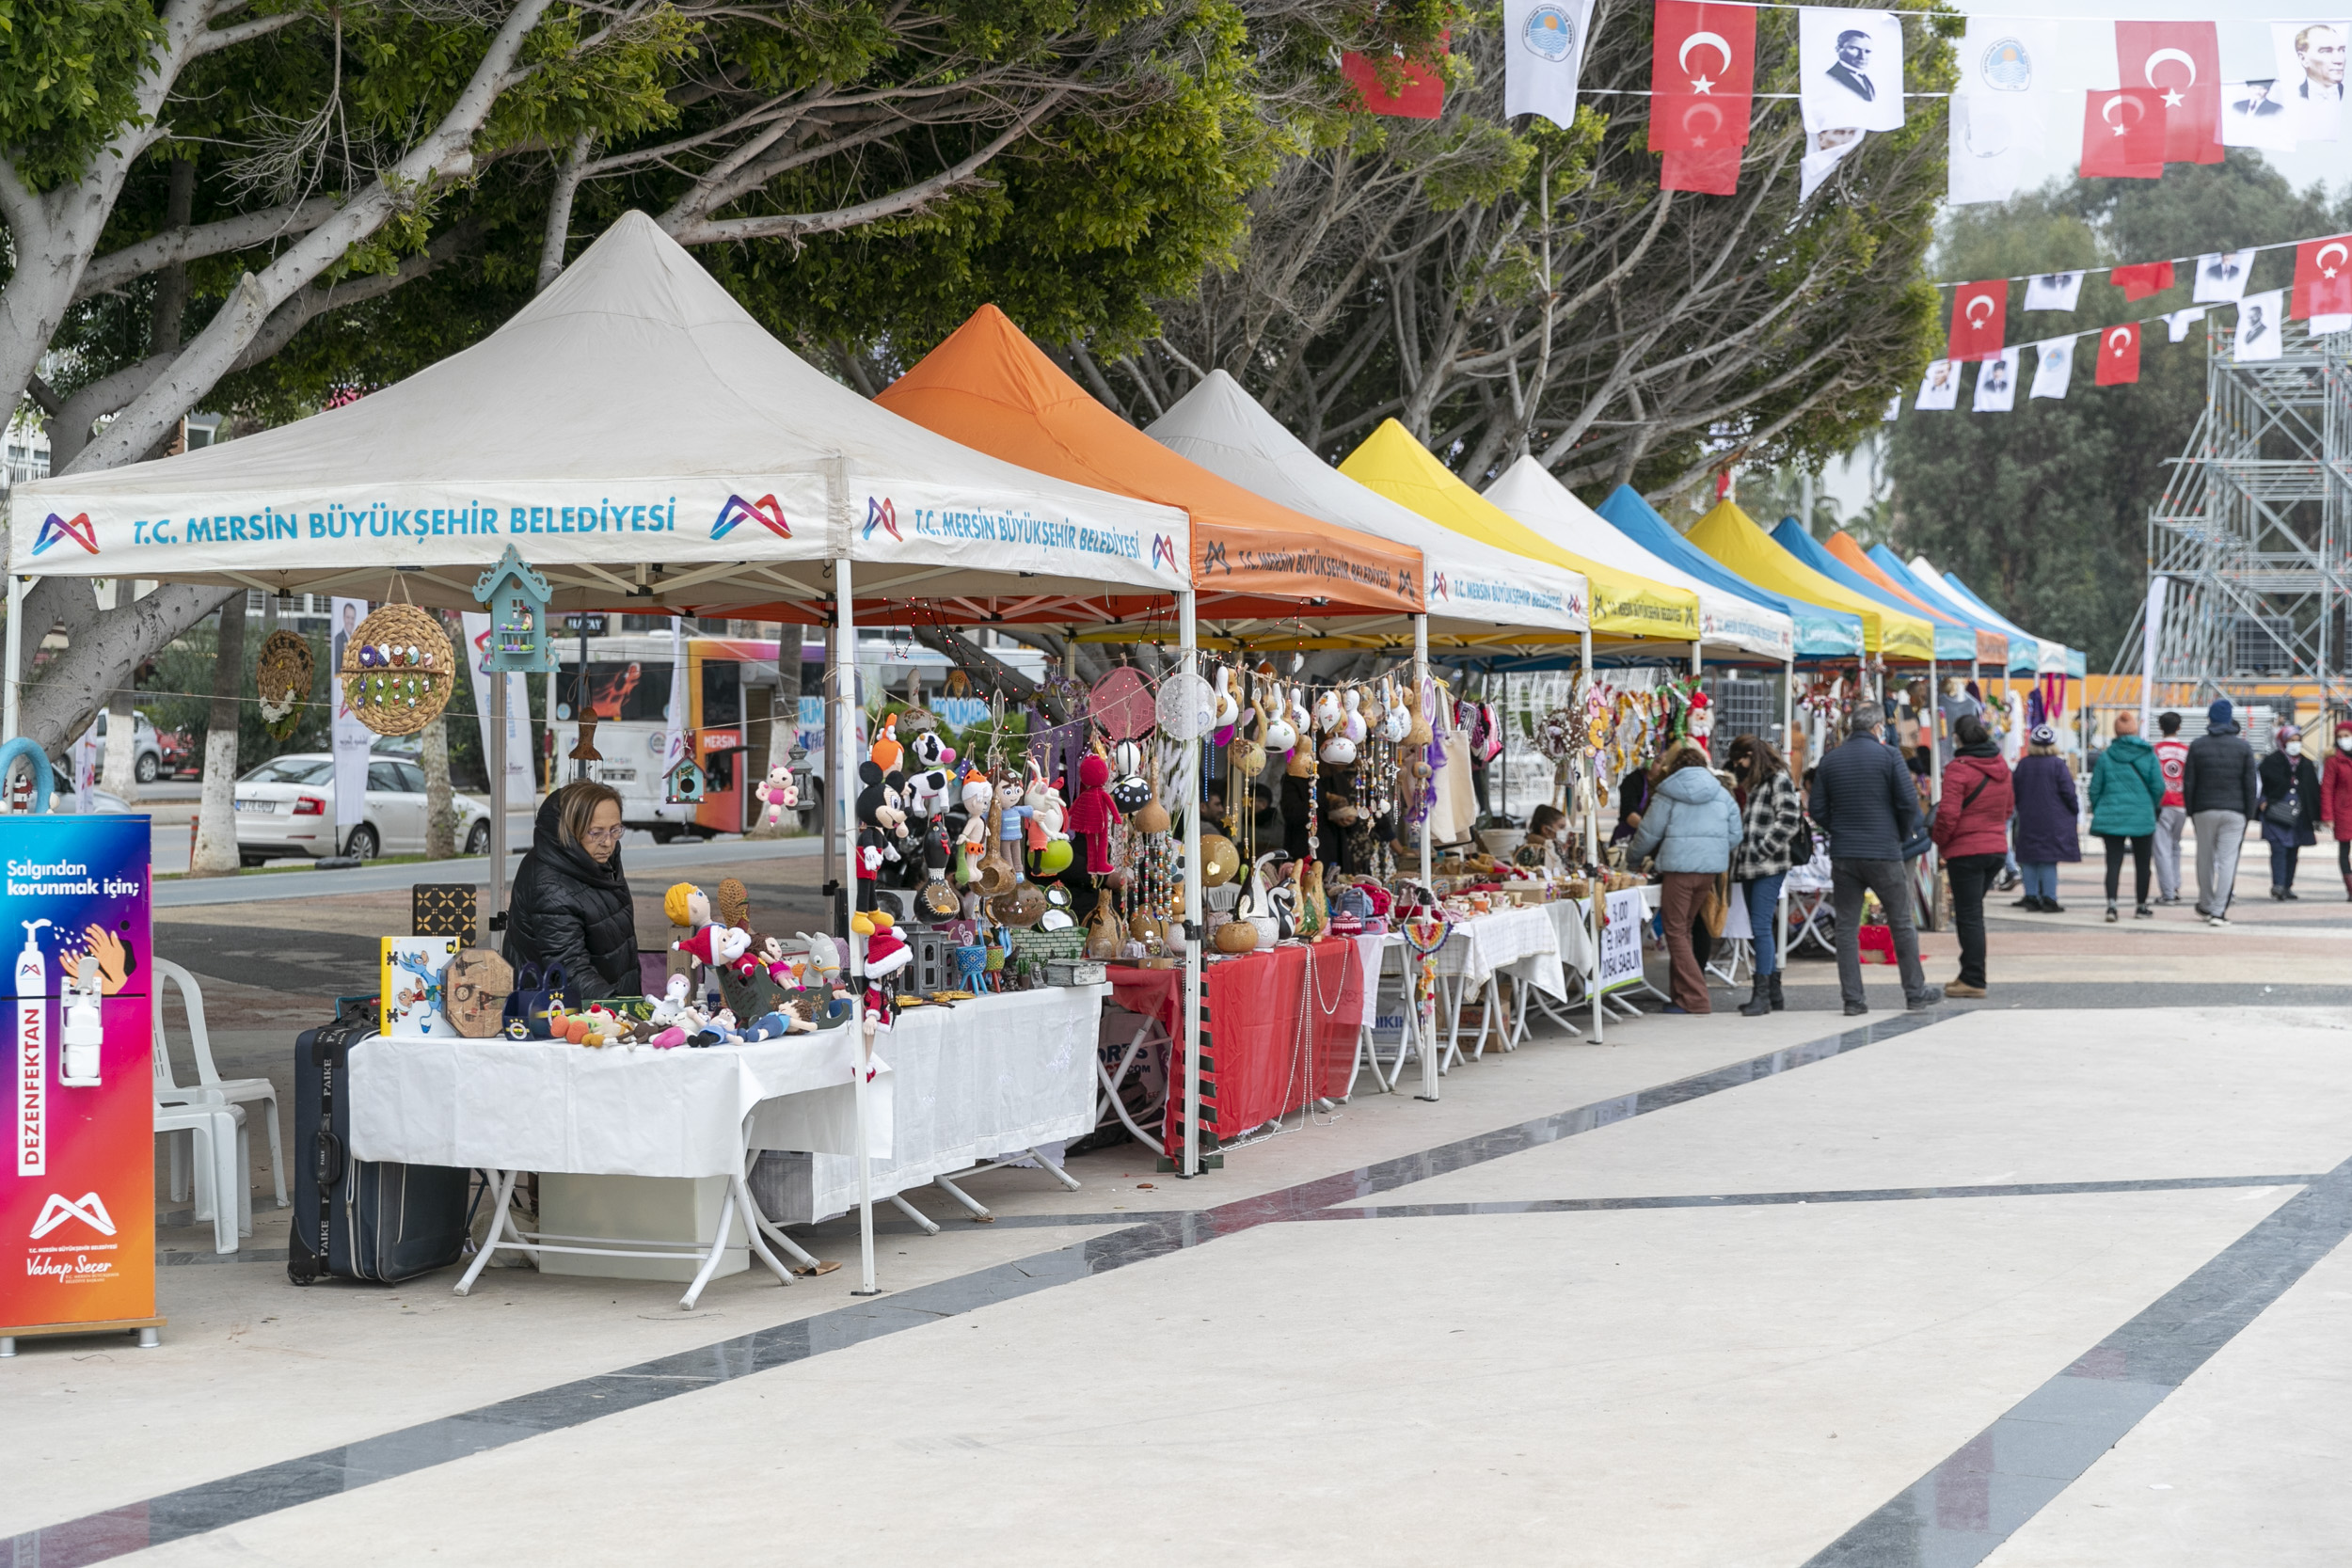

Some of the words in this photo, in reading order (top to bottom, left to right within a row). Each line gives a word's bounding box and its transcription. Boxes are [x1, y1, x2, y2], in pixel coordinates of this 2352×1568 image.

[134, 520, 179, 545] T.C.
[186, 506, 297, 542] MERSİN
[310, 499, 498, 545] BÜYÜKŞEHİR
[509, 497, 676, 533] BELEDİYESİ
[914, 509, 940, 535] T.C.
[943, 506, 995, 540] MERSİN
[999, 509, 1075, 554] BÜYÜKŞEHİR
[1079, 526, 1141, 560] BELEDİYESİ
[1239, 550, 1258, 570] T.C.
[1258, 547, 1295, 573] MERSİN
[1295, 548, 1349, 582] BÜYÜKŞEHİR
[1351, 562, 1391, 589] BELEDİYESİ
[7, 860, 87, 879] Salgından
[7, 879, 99, 897] korunmak
[103, 879, 139, 900] için;
[24, 1008, 40, 1165] DEZENFEKTAN
[323, 1059, 331, 1096] PAIKE
[26, 1255, 72, 1283] Vahap
[75, 1254, 112, 1274] Seçer
